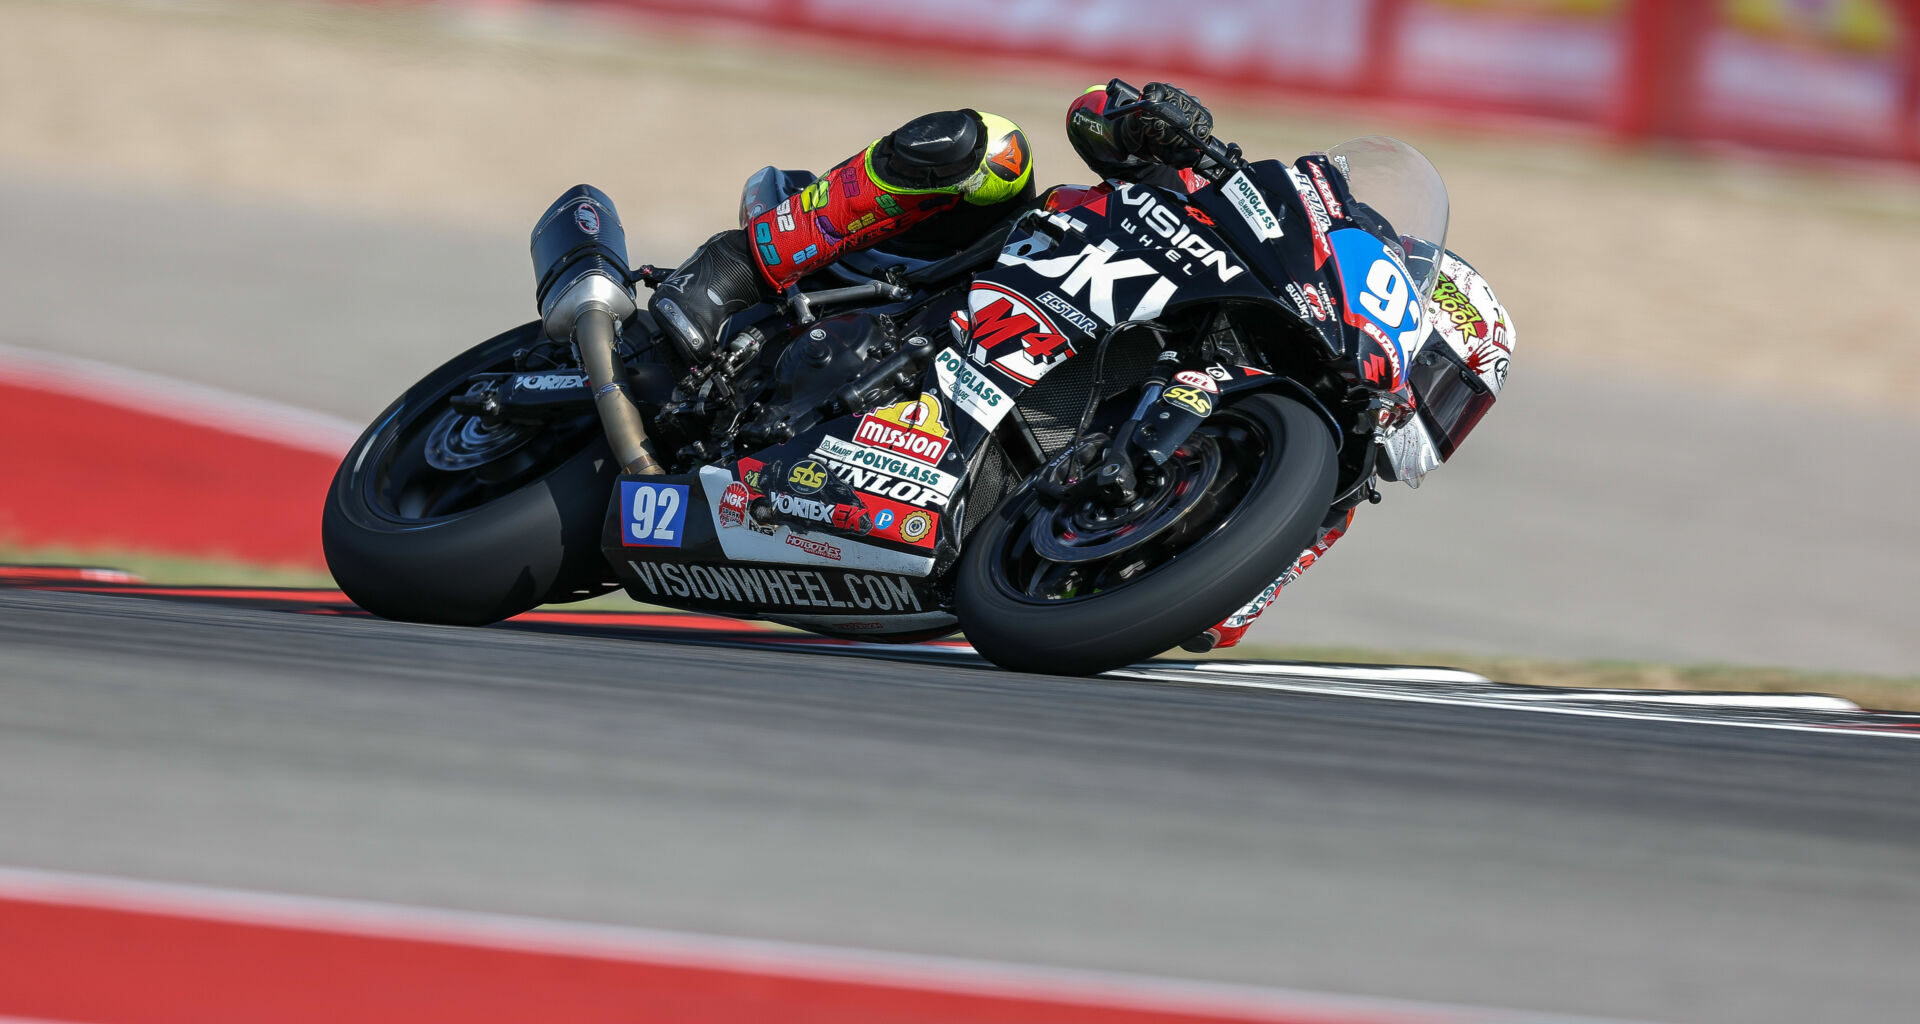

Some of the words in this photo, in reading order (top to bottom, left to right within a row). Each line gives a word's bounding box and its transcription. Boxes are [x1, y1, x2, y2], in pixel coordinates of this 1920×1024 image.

[842, 166, 860, 198] 92
[1294, 171, 1331, 226] ECSTAR
[776, 199, 796, 233] 92
[1233, 176, 1277, 231] POLYGLASS
[755, 222, 782, 266] 92
[792, 244, 818, 265] 92
[1120, 185, 1245, 283] VISION
[1038, 292, 1096, 338] ECSTAR
[1285, 283, 1310, 319] SUZUKI
[1318, 281, 1338, 322] VISION
[973, 296, 1067, 356] M4
[1362, 322, 1400, 378] SUZUKI
[514, 374, 589, 391] VORTEX
[939, 350, 1003, 408] POLYGLASS
[1182, 374, 1210, 387] HEL
[860, 420, 943, 460] MISSION
[808, 453, 949, 508] UNLOP
[852, 449, 941, 486] POLYGLASS
[631, 485, 680, 540] 92
[724, 492, 745, 509] NGK
[771, 491, 832, 524] VORTEX
[832, 503, 870, 532] EK
[628, 560, 922, 611] VISIONWHEEL.COM
